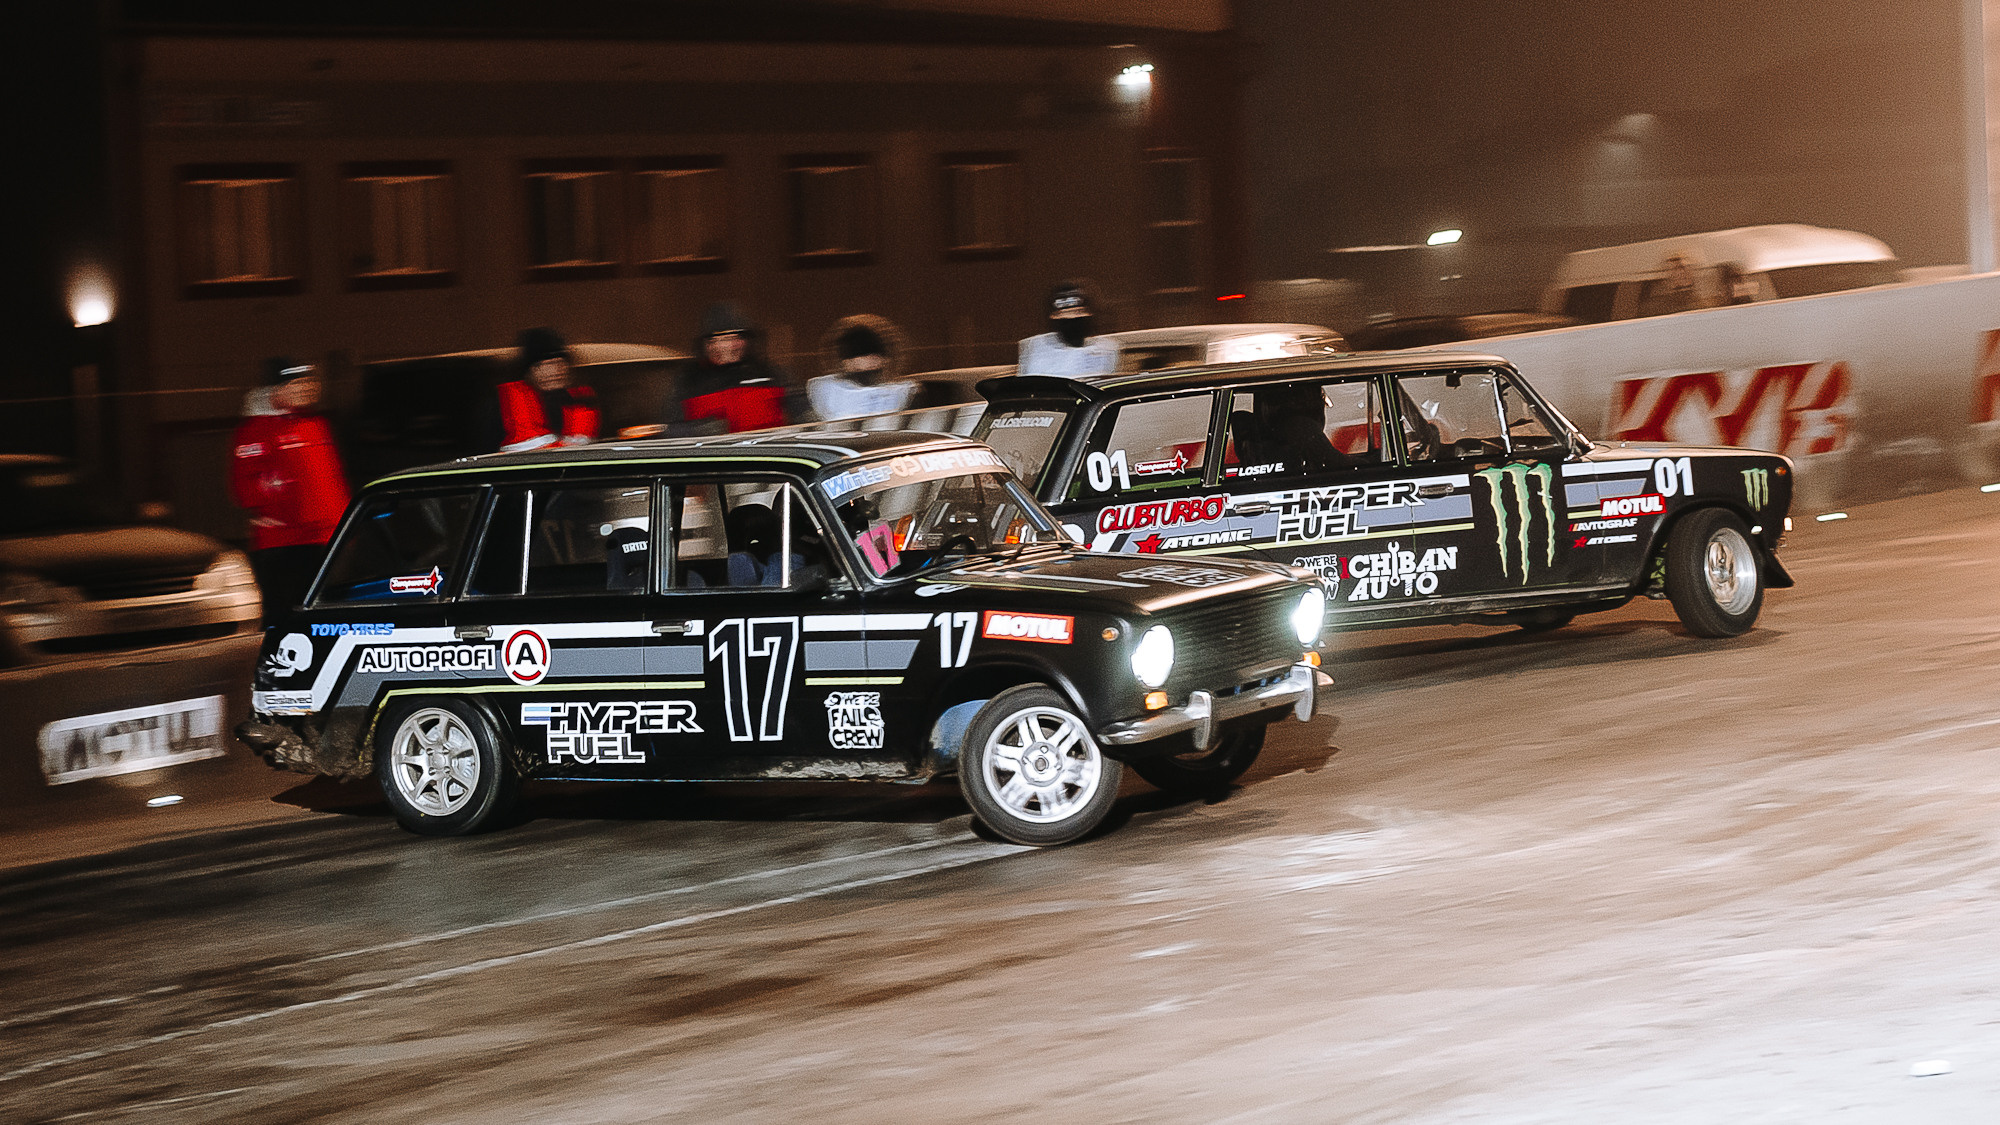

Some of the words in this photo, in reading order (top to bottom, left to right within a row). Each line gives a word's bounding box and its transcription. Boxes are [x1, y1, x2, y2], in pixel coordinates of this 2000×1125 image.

[821, 466, 894, 500] Winter
[1086, 449, 1131, 492] 01
[1238, 463, 1275, 477] LOSEV
[1274, 462, 1285, 472] E.
[1653, 457, 1695, 498] 01
[1272, 481, 1425, 514] HYPER
[1601, 496, 1663, 517] MOTUL
[1096, 494, 1230, 534] CLUBTURBO
[1276, 510, 1369, 545] FUEL
[1577, 518, 1638, 532] AVTOGRAF
[857, 524, 898, 575] 17
[1161, 529, 1251, 550] ATOMIC
[311, 624, 349, 636] TOYO
[351, 623, 395, 635] TIRES
[934, 612, 978, 668] 17
[985, 615, 1070, 641] MOTUL
[357, 645, 496, 672] AUTOPROFI
[708, 616, 799, 741] 17
[547, 701, 704, 734] HYPER
[830, 708, 867, 727] FAIL
[547, 733, 645, 763] FUEL
[832, 728, 881, 746] CREW
